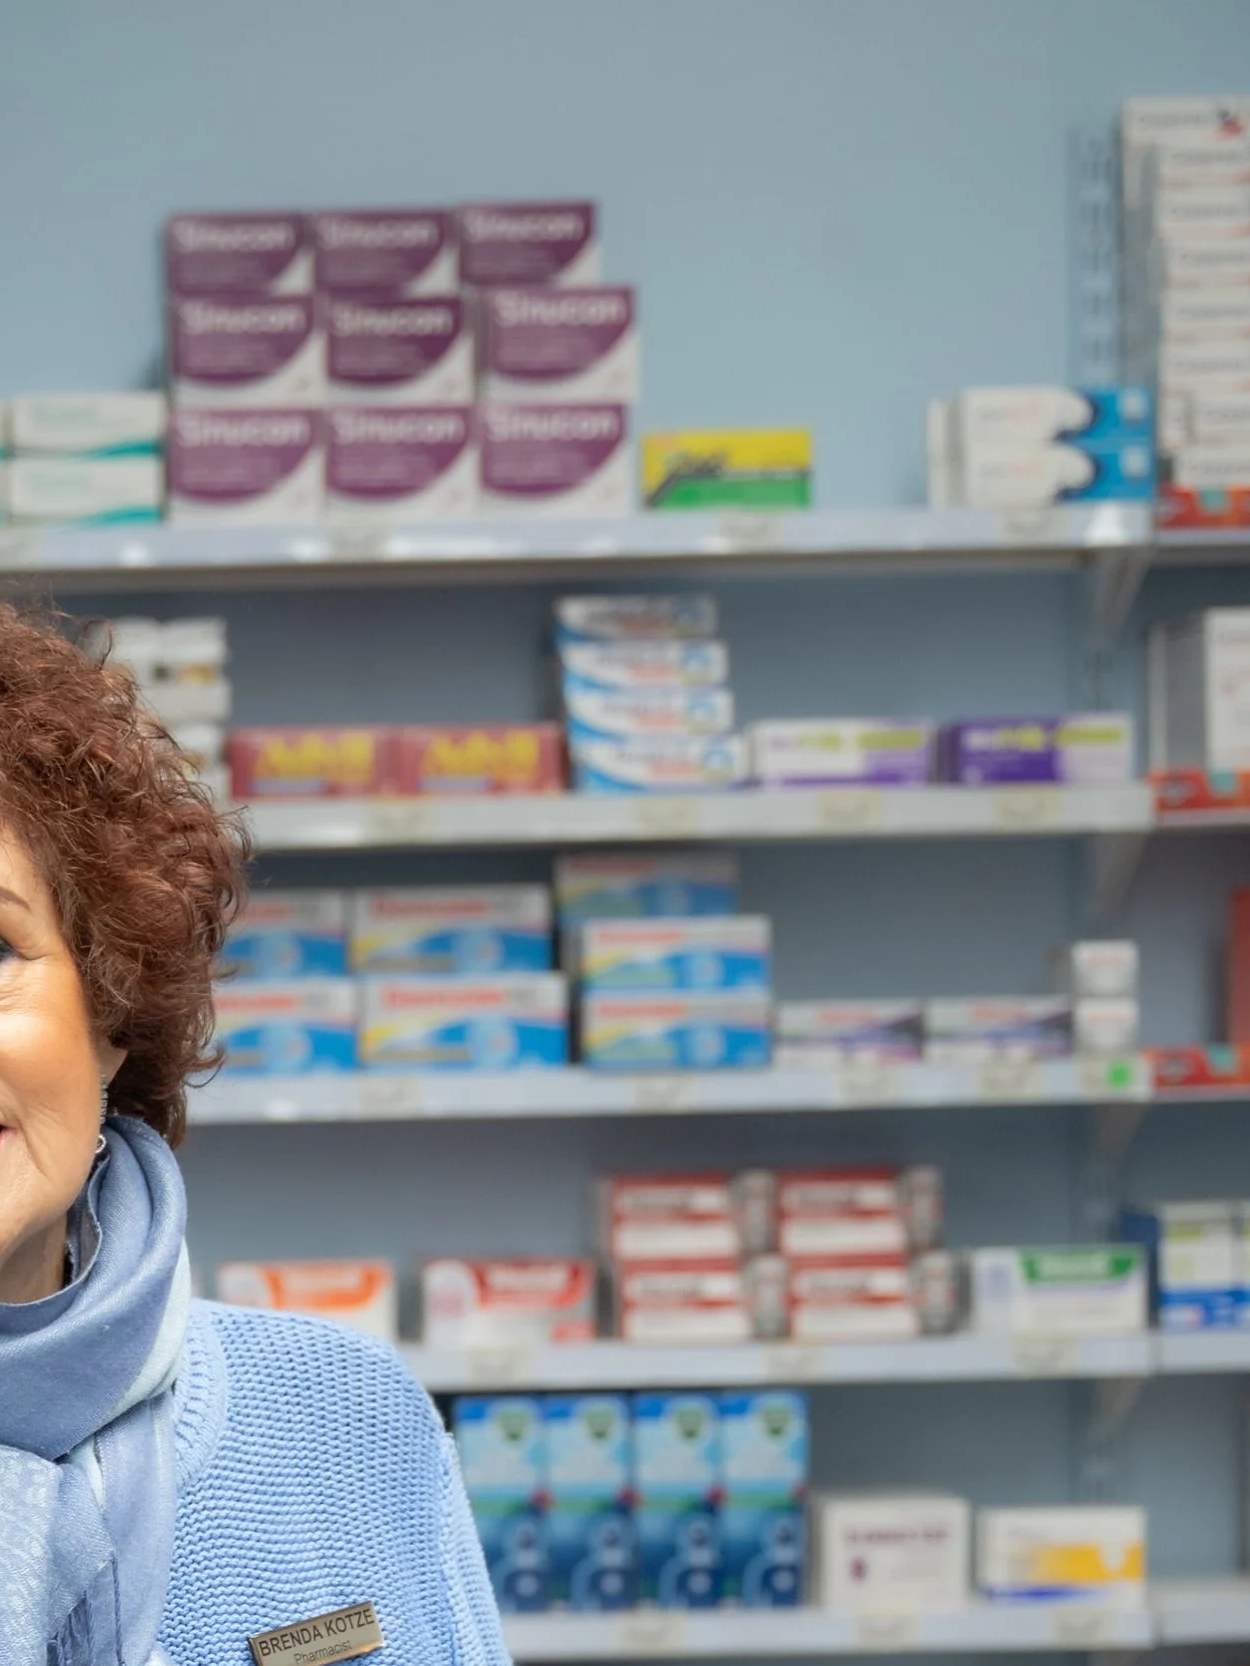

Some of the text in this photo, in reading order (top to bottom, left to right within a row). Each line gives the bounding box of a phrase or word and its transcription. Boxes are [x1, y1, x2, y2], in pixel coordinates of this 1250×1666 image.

[259, 1608, 375, 1656] BRENDA KOTZE
[294, 1640, 352, 1664] Pharmacist
